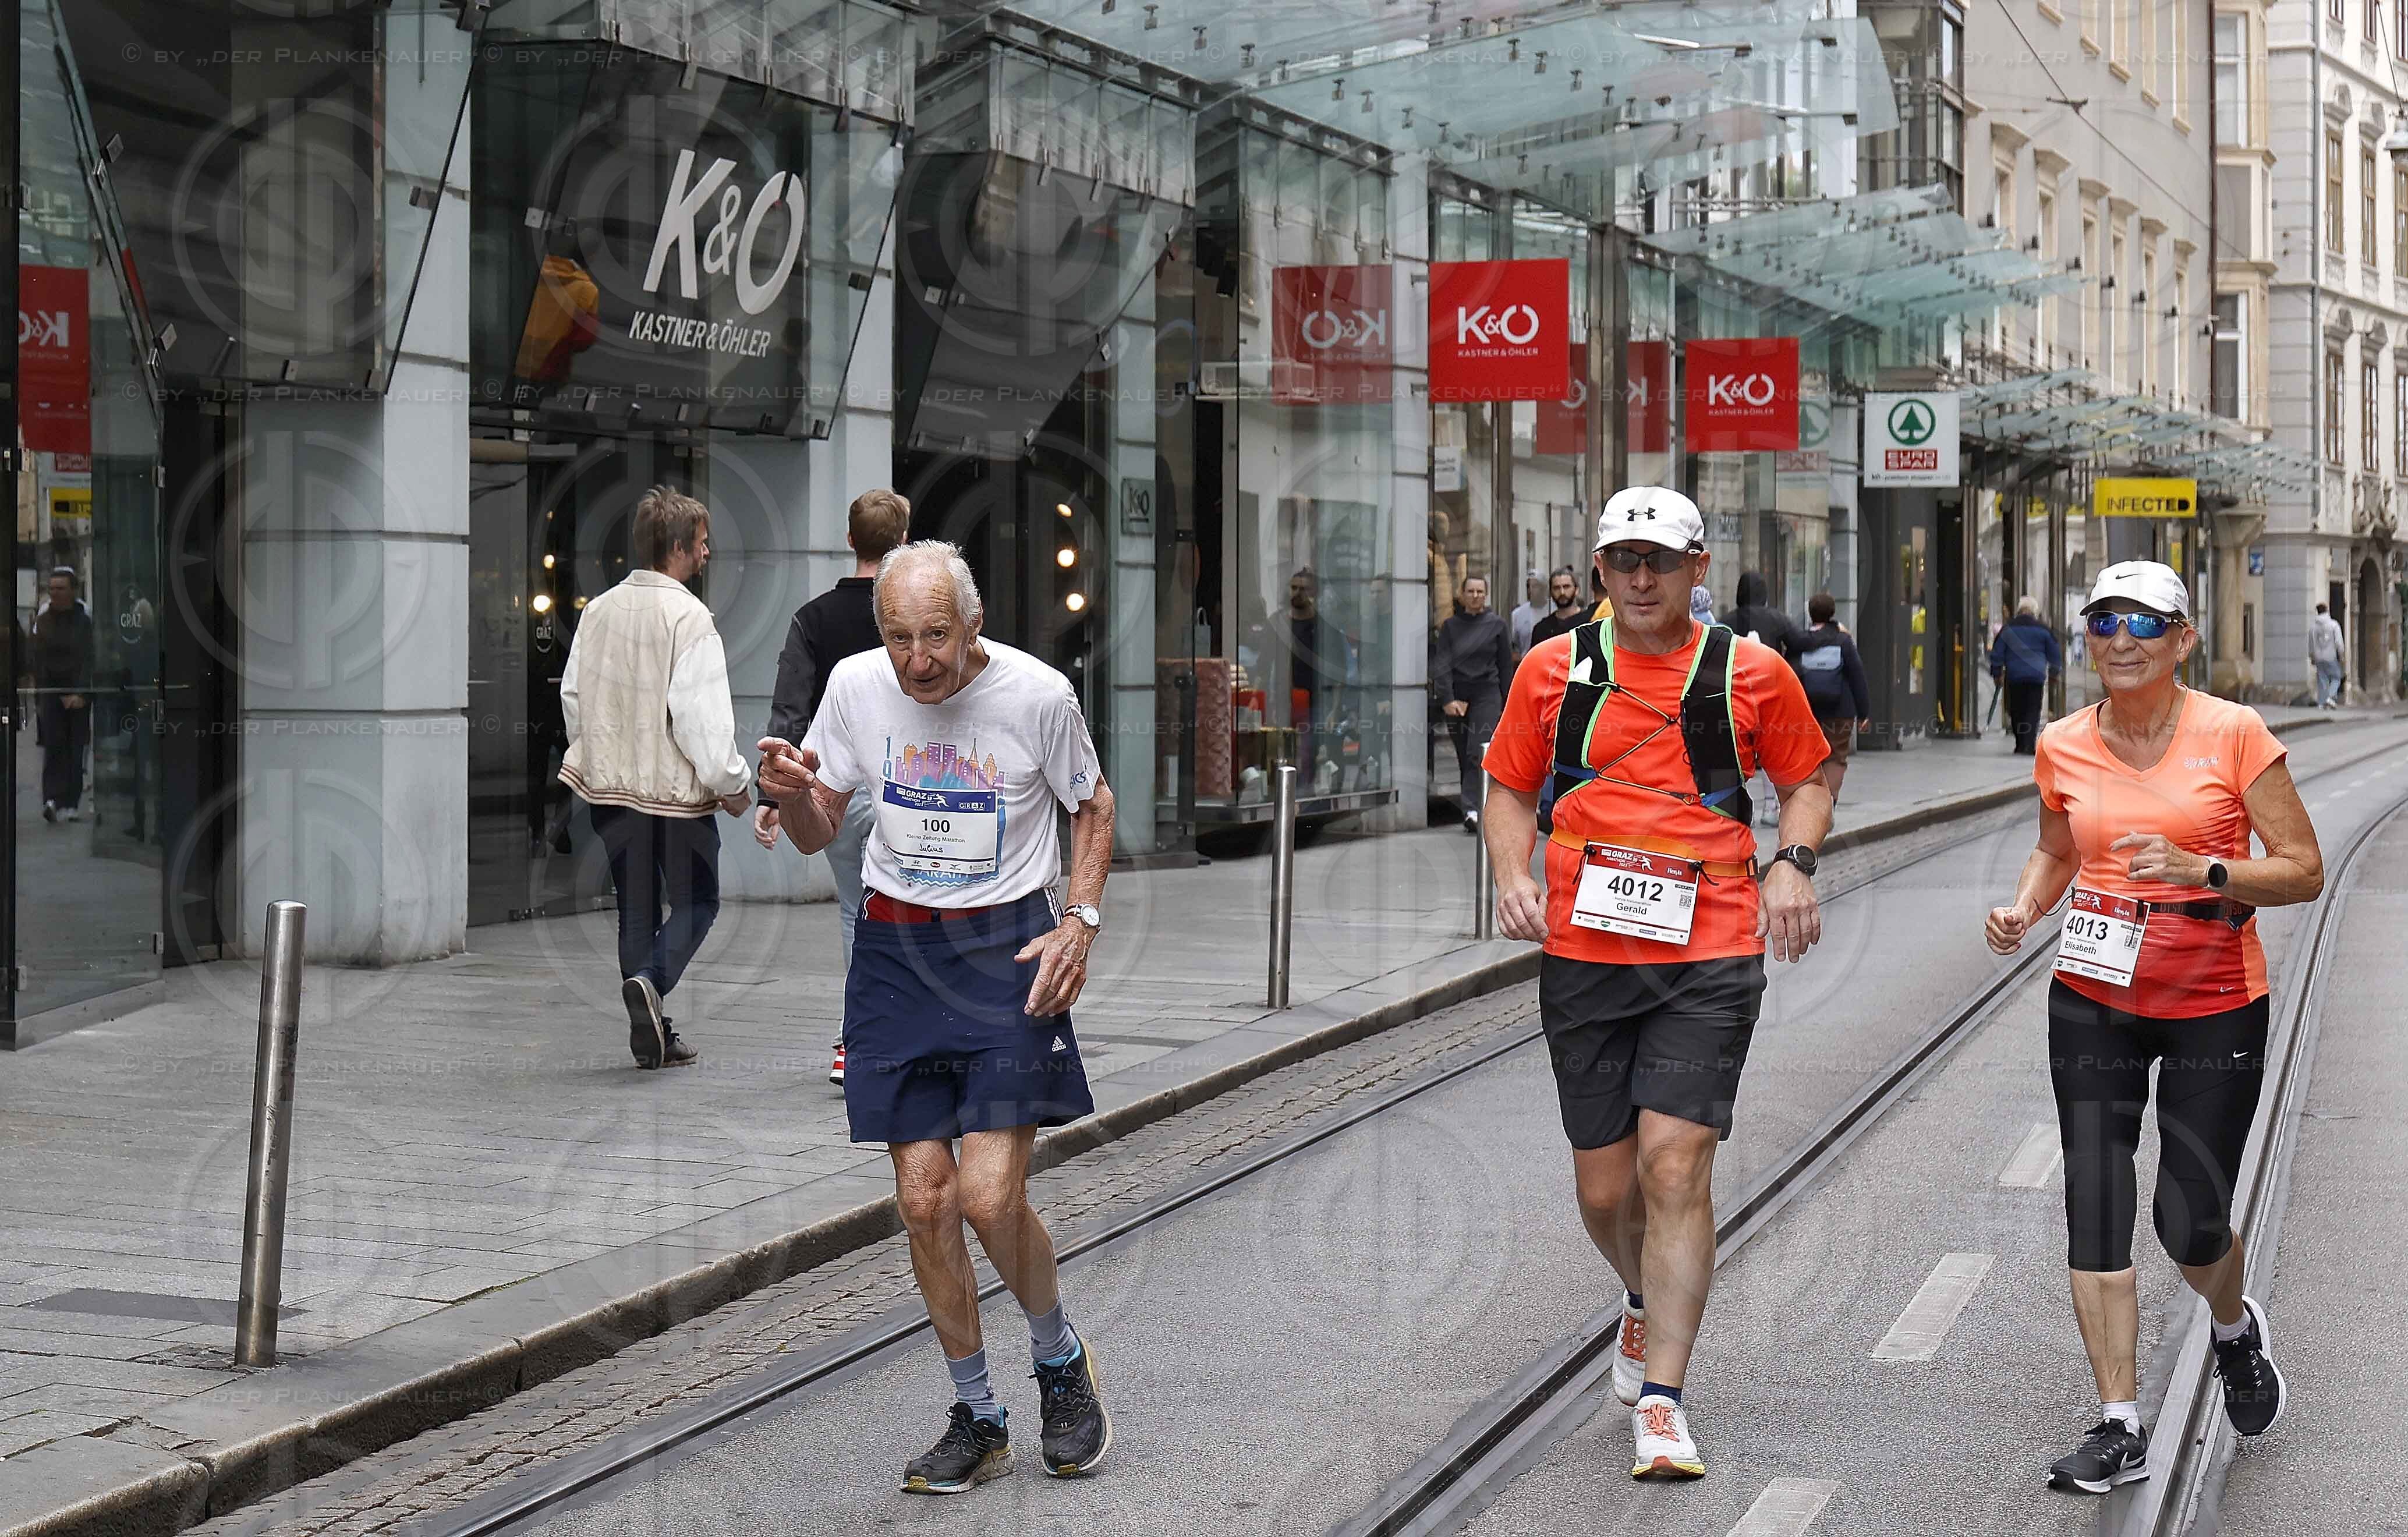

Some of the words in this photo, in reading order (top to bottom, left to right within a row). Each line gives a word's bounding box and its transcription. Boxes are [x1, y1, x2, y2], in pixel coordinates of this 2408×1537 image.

[2107, 497, 2190, 511] INFECTED
[906, 788, 927, 799] GRAZ
[922, 818, 951, 833] 100
[1612, 850, 1634, 860] GRAZ
[1607, 875, 1664, 902] 4012
[1616, 902, 1647, 915] Gerald
[2066, 915, 2109, 940] 4013
[2064, 941, 2097, 955] Elisabeth
